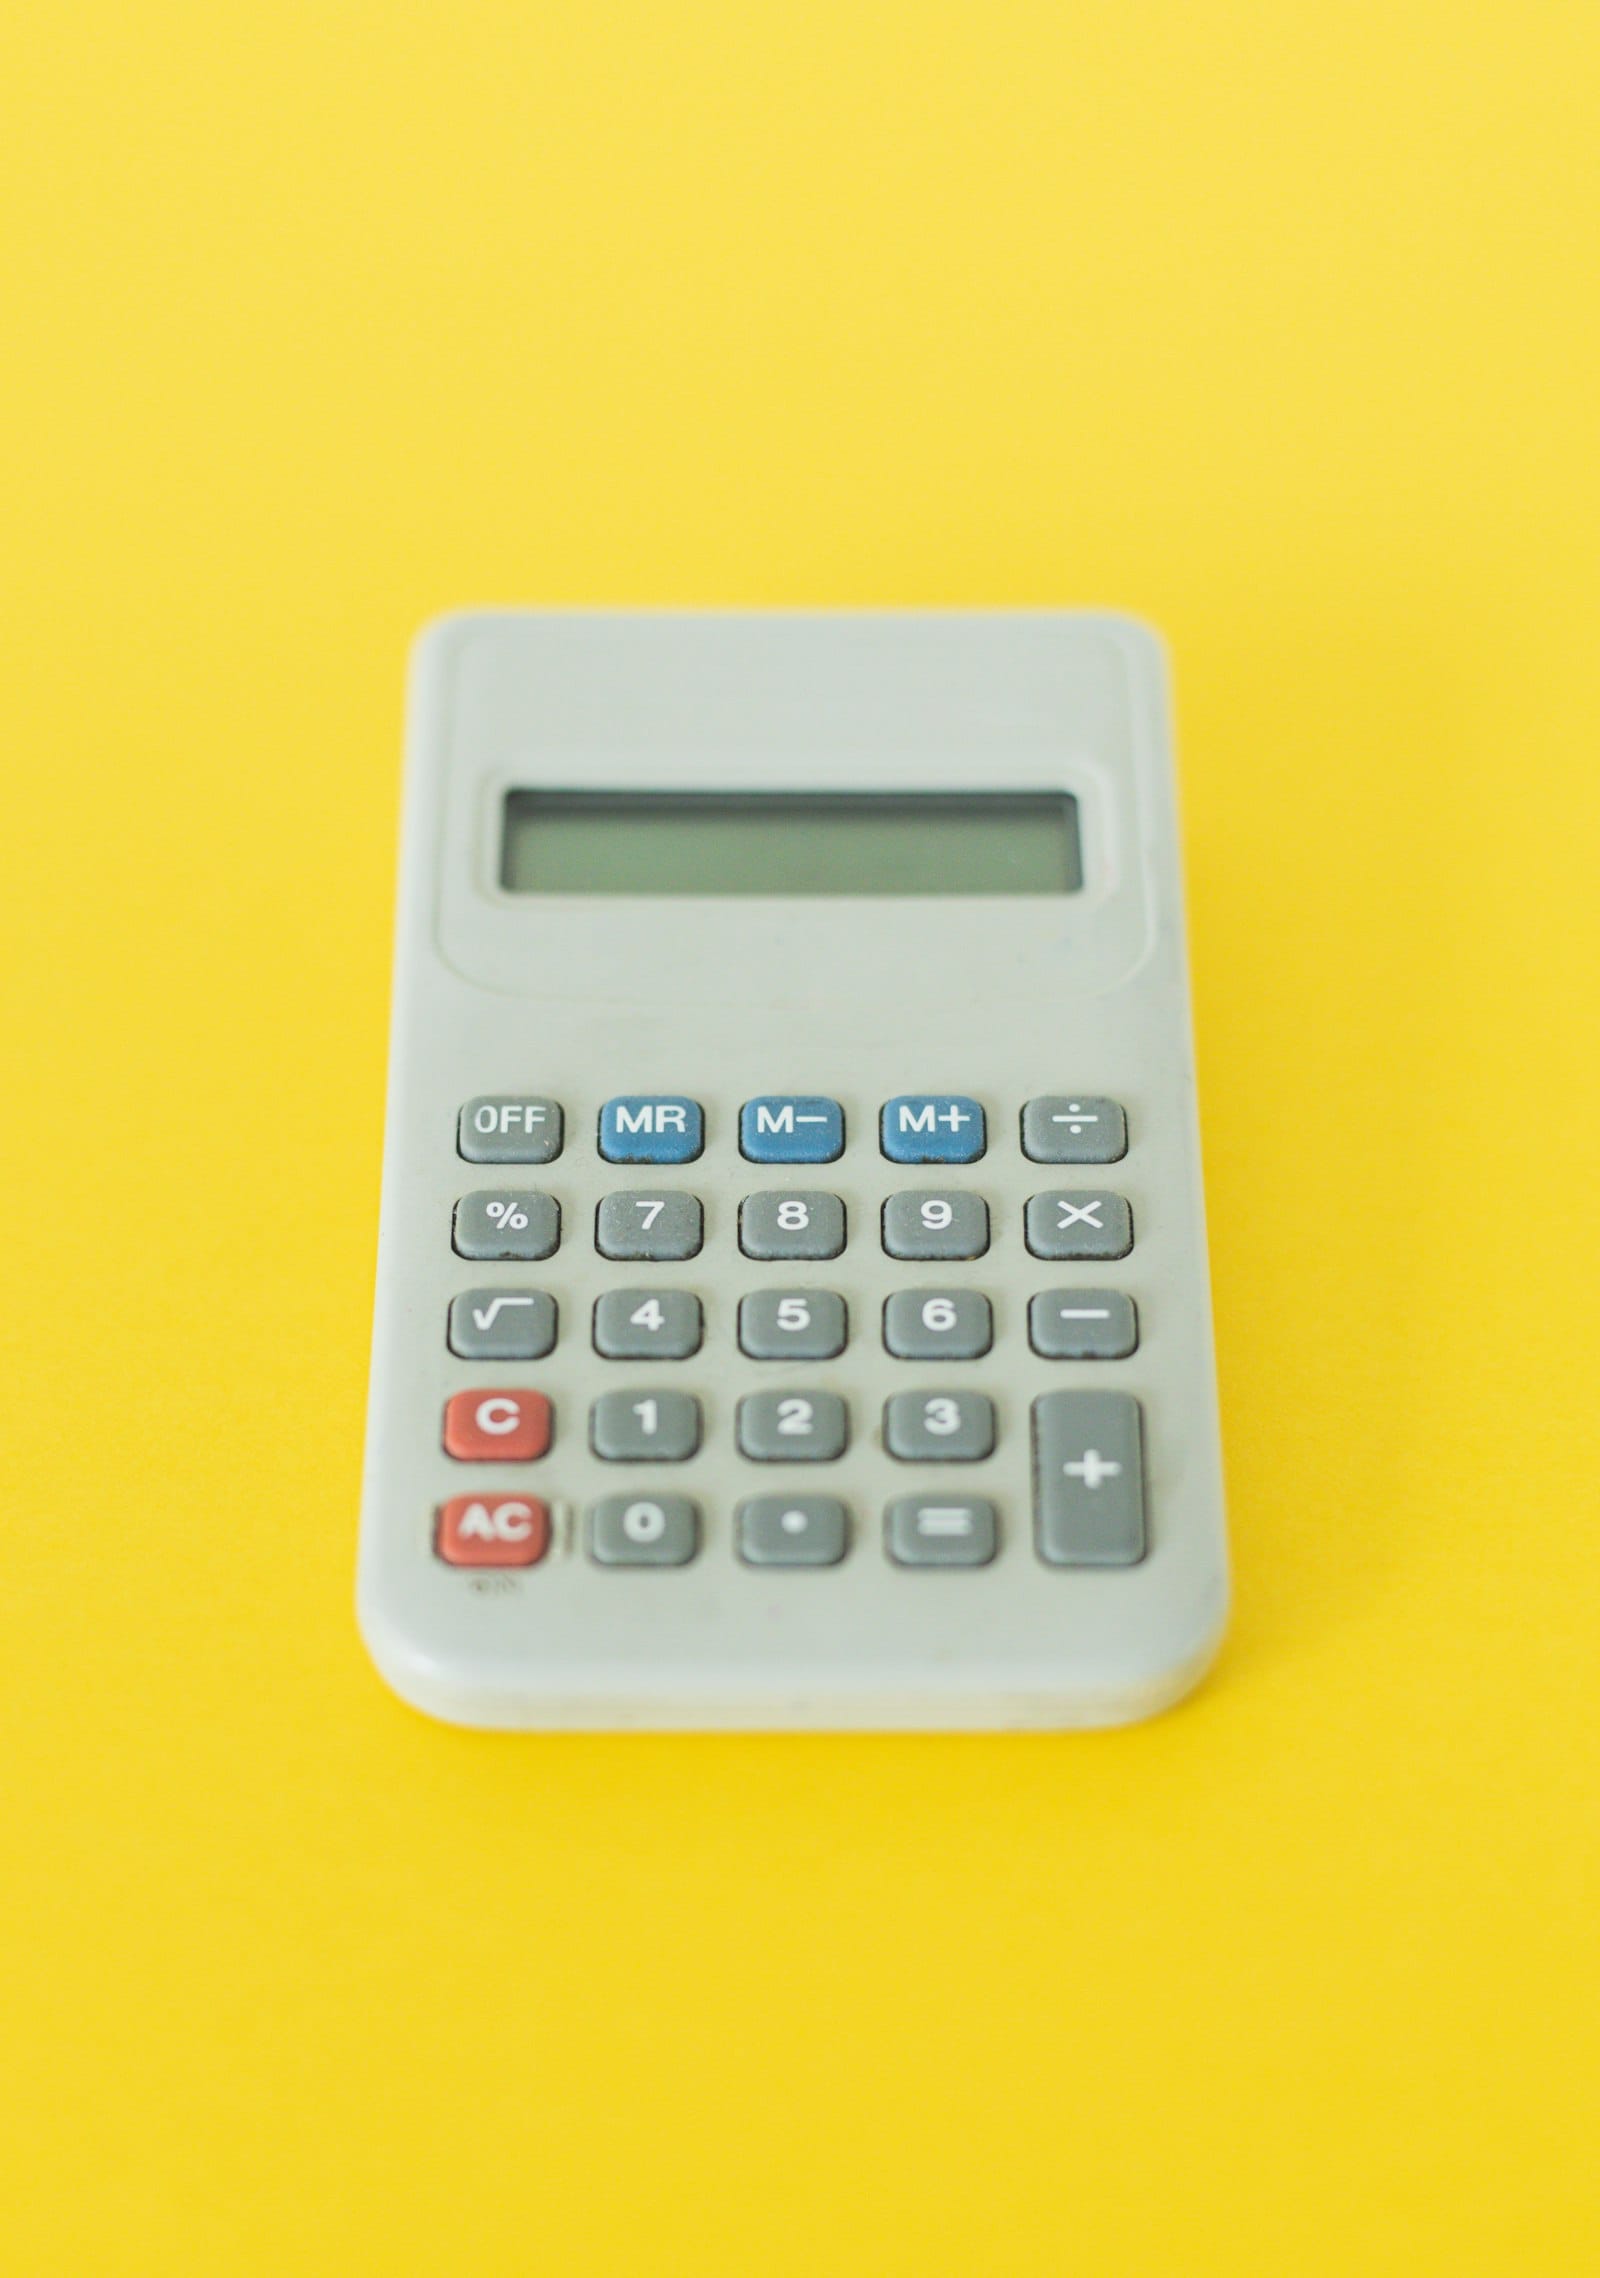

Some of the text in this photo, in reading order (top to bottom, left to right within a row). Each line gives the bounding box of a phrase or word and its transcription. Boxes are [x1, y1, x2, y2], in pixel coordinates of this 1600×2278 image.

[474, 1105, 546, 1134] OFF
[616, 1104, 686, 1133] MR
[899, 1104, 971, 1133] M+
[485, 1201, 529, 1230] %
[635, 1200, 665, 1230] 7
[776, 1200, 809, 1231] 8
[920, 1199, 953, 1230] 9
[630, 1299, 665, 1331] 4
[777, 1298, 811, 1331] 5
[922, 1298, 957, 1331] 6
[475, 1397, 519, 1435] C
[634, 1399, 657, 1434] 1
[777, 1398, 813, 1435] 2
[924, 1398, 960, 1435] 3
[1063, 1449, 1119, 1488] +
[459, 1502, 531, 1541] AC
[623, 1502, 665, 1542] 0
